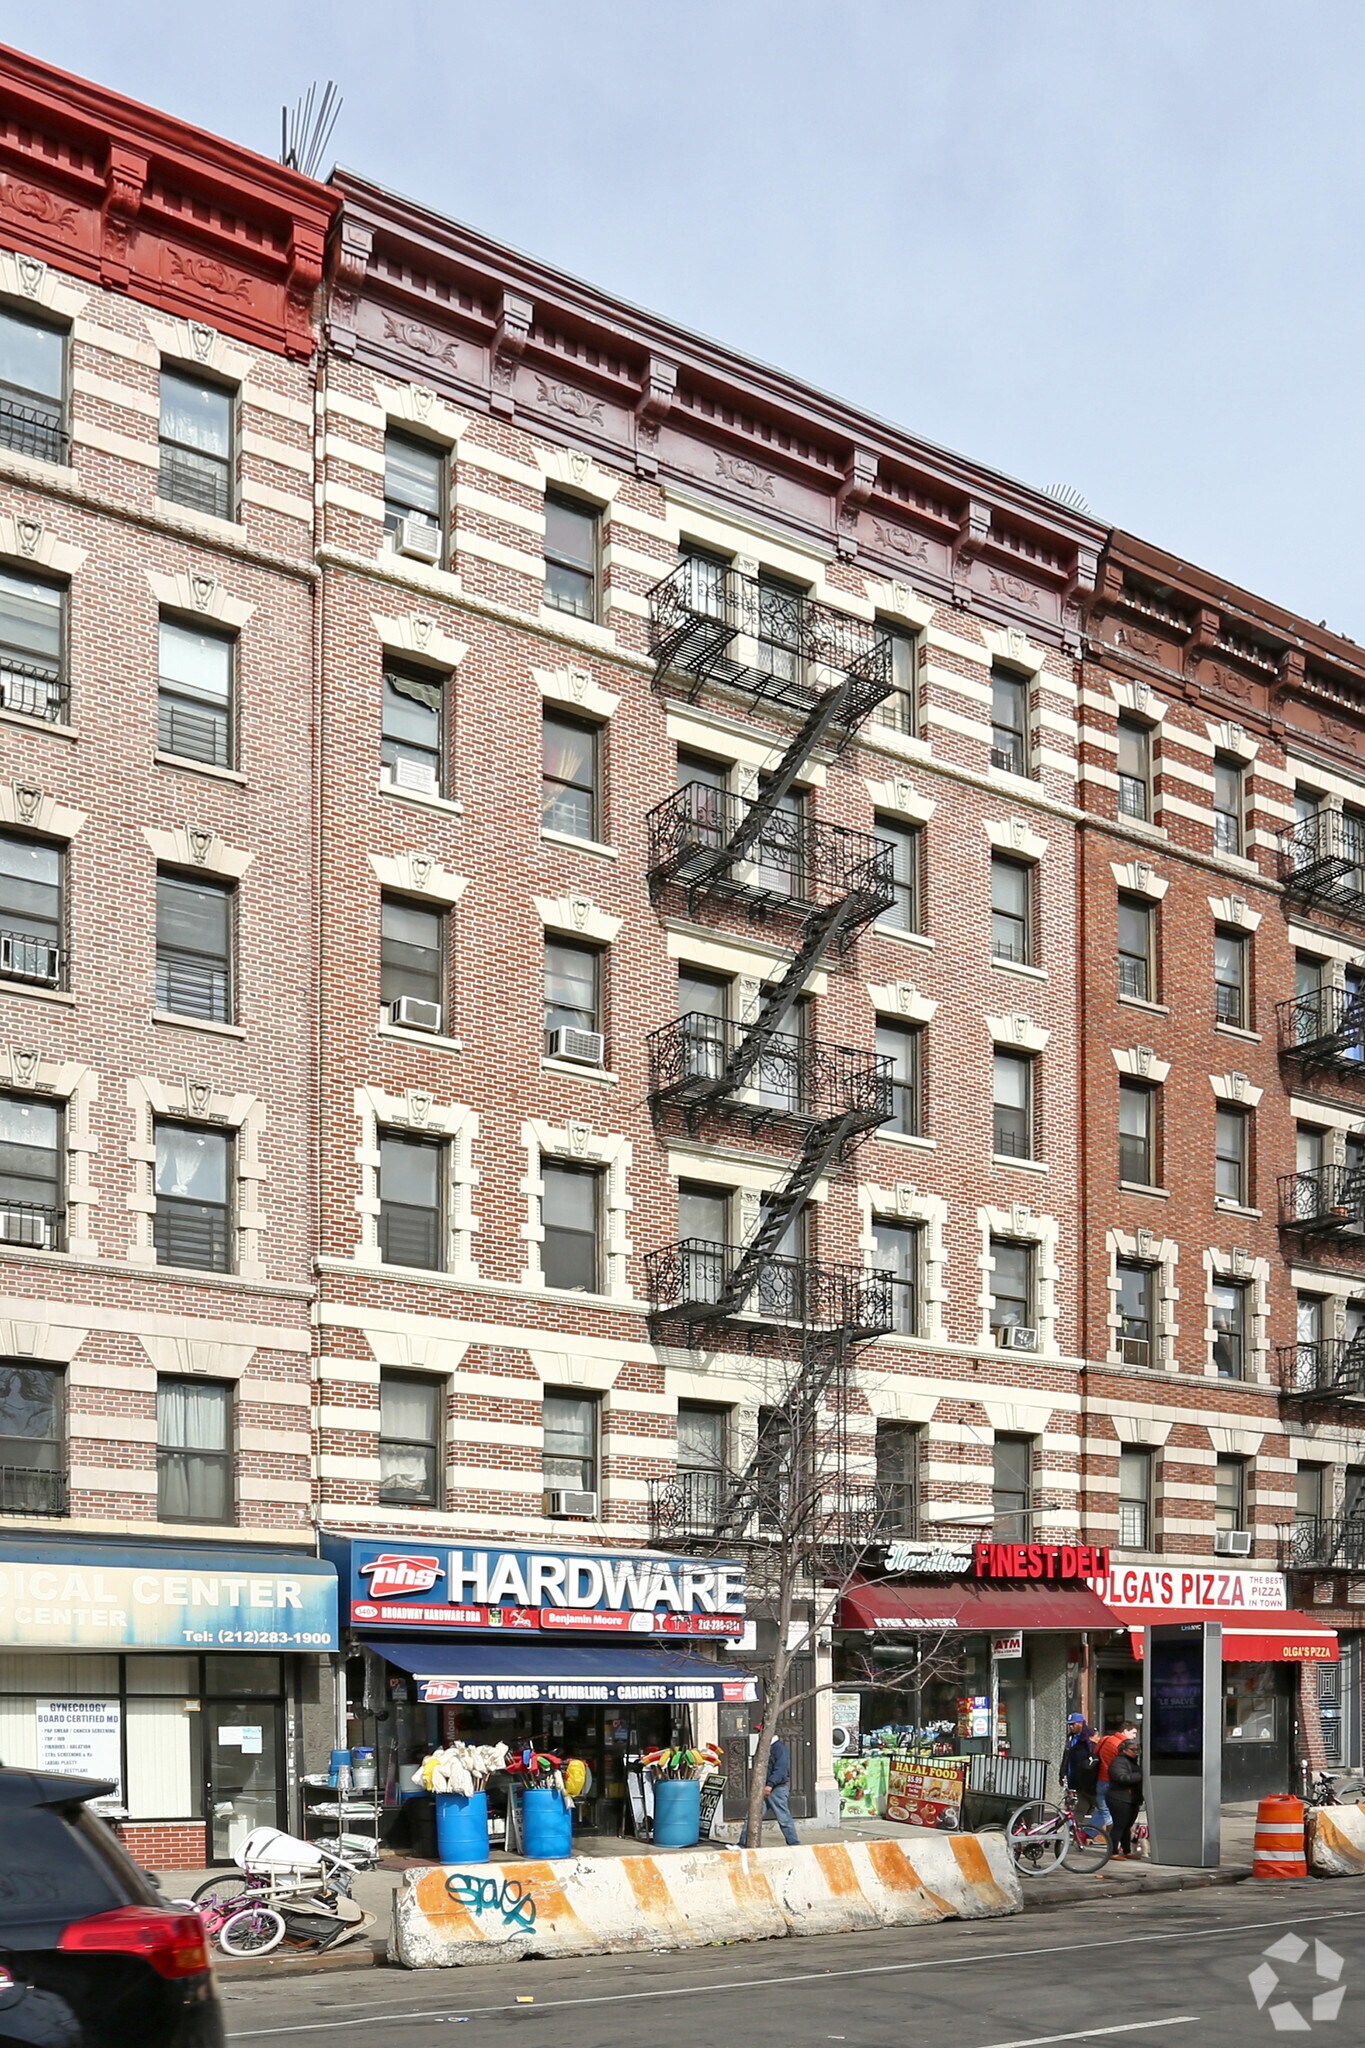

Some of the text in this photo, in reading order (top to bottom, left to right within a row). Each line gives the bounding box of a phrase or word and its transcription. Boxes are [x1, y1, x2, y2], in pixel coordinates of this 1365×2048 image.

[884, 1545, 972, 1573] Hamilton
[975, 1543, 1110, 1580] FINEST DELI
[373, 1562, 434, 1586] nhs
[1250, 1576, 1284, 1585] THE BEST
[448, 1551, 747, 1613] HARDWARE
[1093, 1571, 1245, 1607] OLGA'S PIZZA
[132, 1575, 304, 1609] CENTER
[1251, 1587, 1282, 1597] PIZZA
[1249, 1599, 1283, 1608] IN TOWN
[14, 1607, 128, 1627] CENTER
[357, 1608, 376, 1616] 3405
[381, 1606, 424, 1620] BROADWAY
[424, 1607, 466, 1621] HARDWARE
[549, 1612, 593, 1626] Benjamin
[593, 1614, 623, 1626] Moore
[873, 1617, 960, 1627] FREE DELIVERY
[183, 1630, 331, 1644] Tel: (212)283-1900
[994, 1639, 1020, 1650] ATM
[1283, 1646, 1331, 1657] OLGA'S PIZZA
[462, 1685, 494, 1700] CUTS
[496, 1684, 540, 1700] WOODS
[548, 1685, 609, 1700] PLUMBLING
[616, 1685, 667, 1700] CABINETS
[674, 1685, 715, 1700] LUMBER
[50, 1703, 106, 1712] GYNECOLOGY
[38, 1714, 119, 1723] BOARD CERTIFIED MD
[895, 1762, 958, 1780] HALAL FOOD
